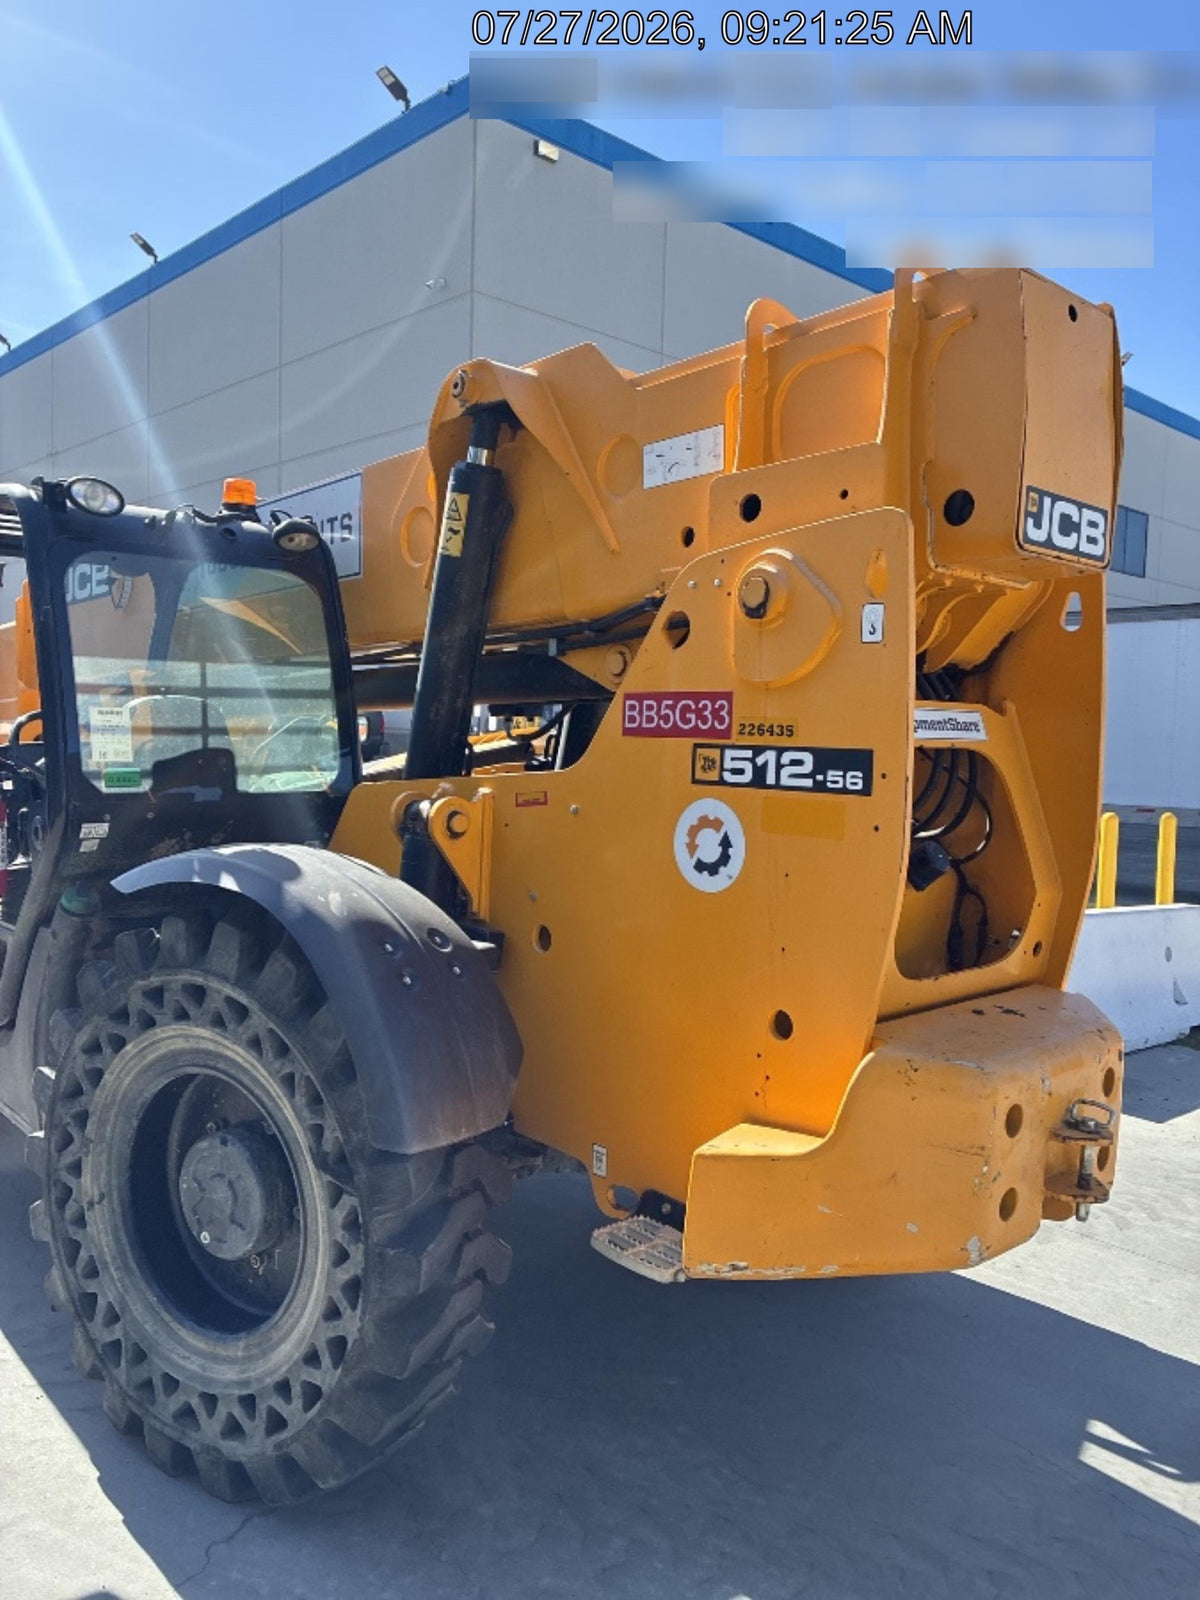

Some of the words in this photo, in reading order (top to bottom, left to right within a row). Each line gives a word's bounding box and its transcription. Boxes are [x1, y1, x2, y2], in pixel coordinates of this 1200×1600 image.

[1026, 495, 1105, 557] JCB
[624, 699, 730, 730] BB5G33
[738, 722, 795, 738] 226435
